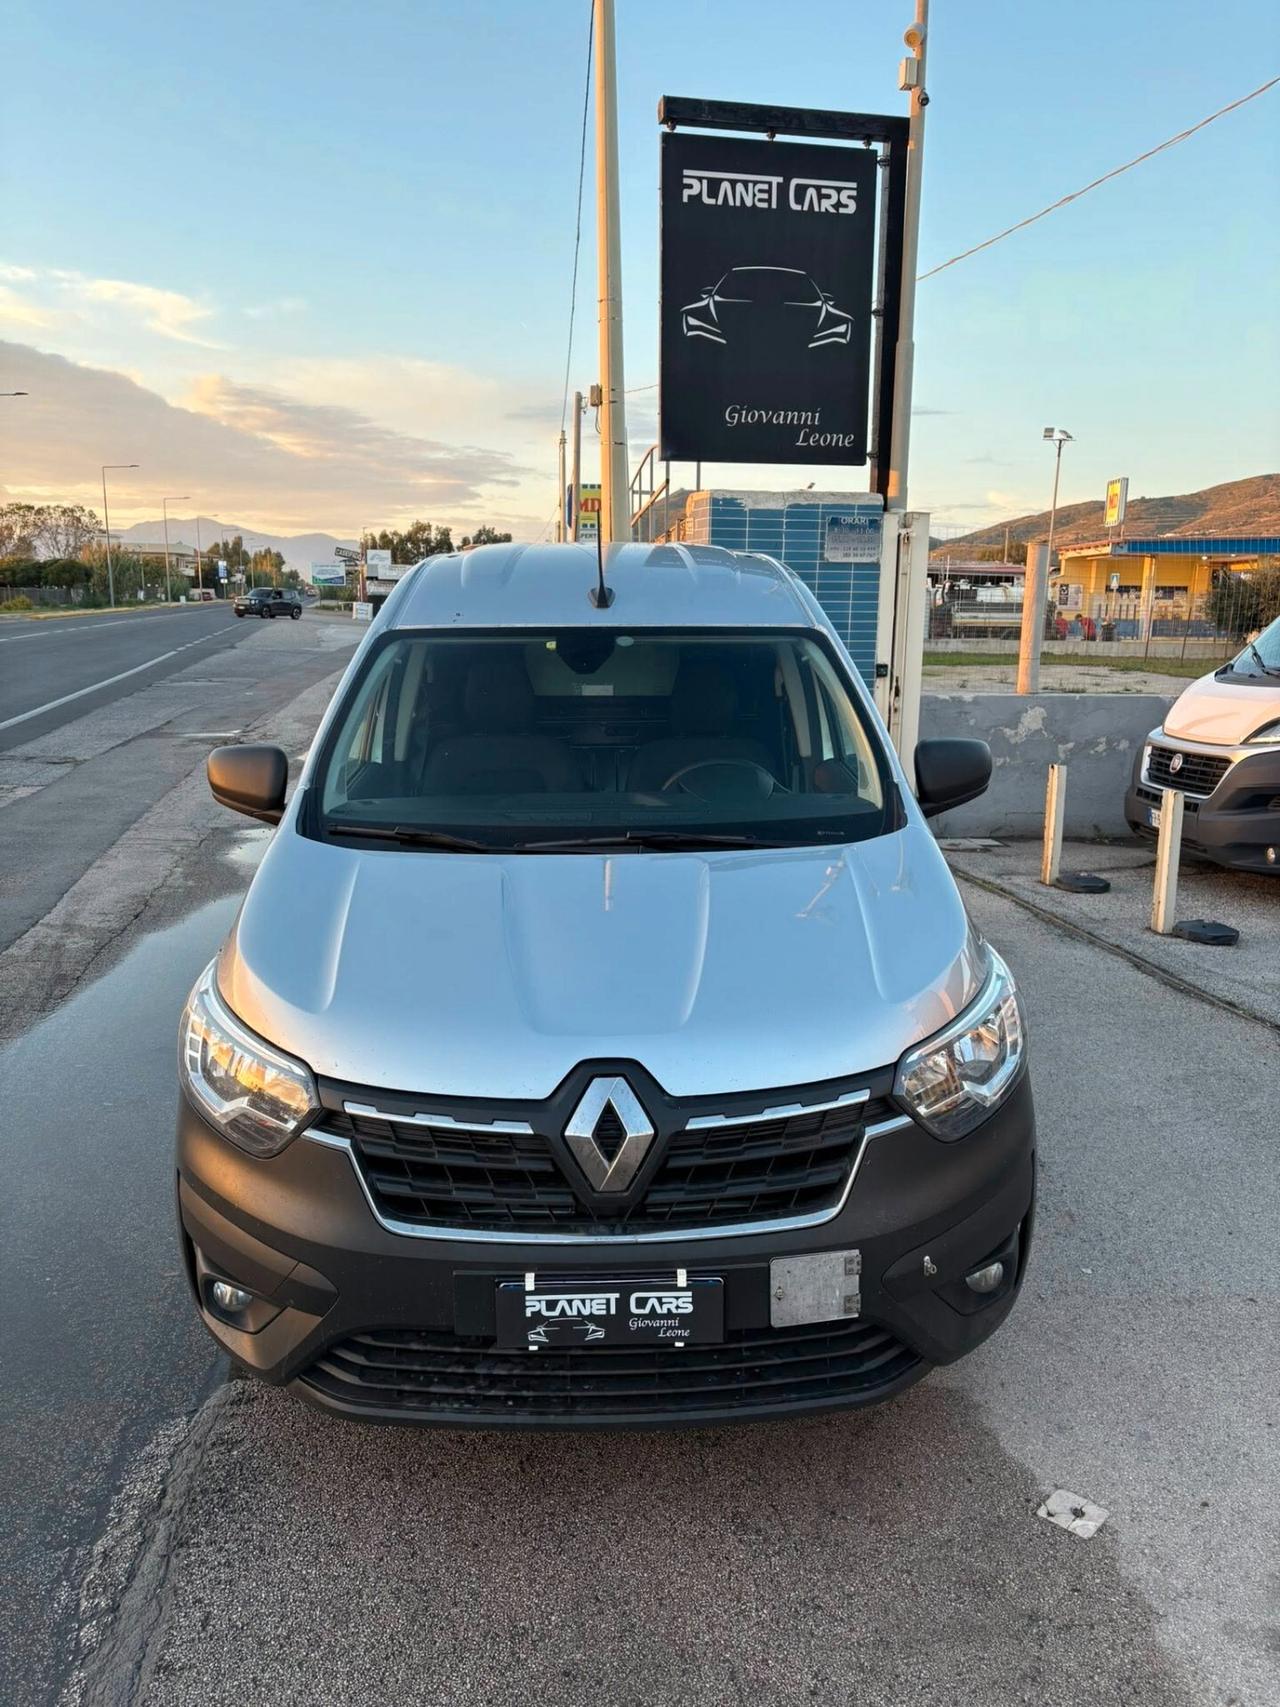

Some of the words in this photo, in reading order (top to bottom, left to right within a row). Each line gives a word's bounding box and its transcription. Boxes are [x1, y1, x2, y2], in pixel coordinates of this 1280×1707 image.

[683, 169, 784, 209] PLANET
[789, 177, 858, 214] CARS
[725, 404, 822, 427] Giovanni
[795, 428, 855, 447] Leone
[525, 1293, 620, 1317] PLANET
[629, 1291, 694, 1315] CARS
[628, 1317, 680, 1331] Giovanni
[657, 1327, 691, 1338] Leone
